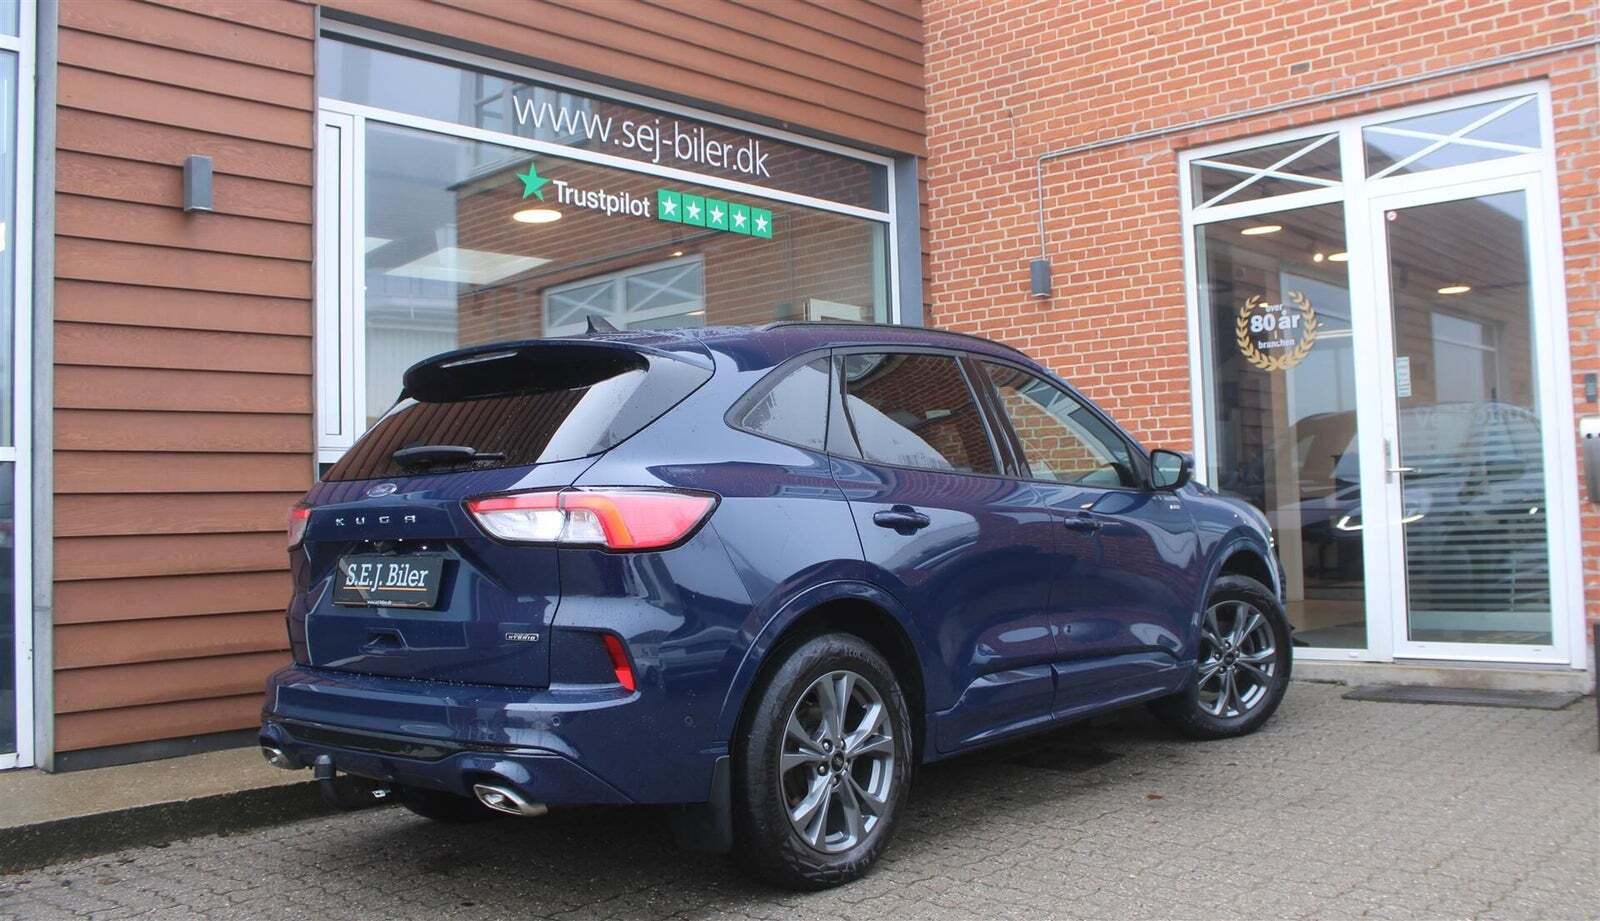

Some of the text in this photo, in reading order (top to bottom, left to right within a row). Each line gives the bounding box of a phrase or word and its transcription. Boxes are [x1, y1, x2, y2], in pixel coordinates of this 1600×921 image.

[513, 96, 770, 177] www.sej-biler.dk
[553, 180, 650, 217] Trustpilot
[1250, 310, 1301, 332] 80 år
[1258, 339, 1296, 350] branchen
[336, 514, 417, 527] KUGA
[345, 563, 429, 592] S.E.J. Biler
